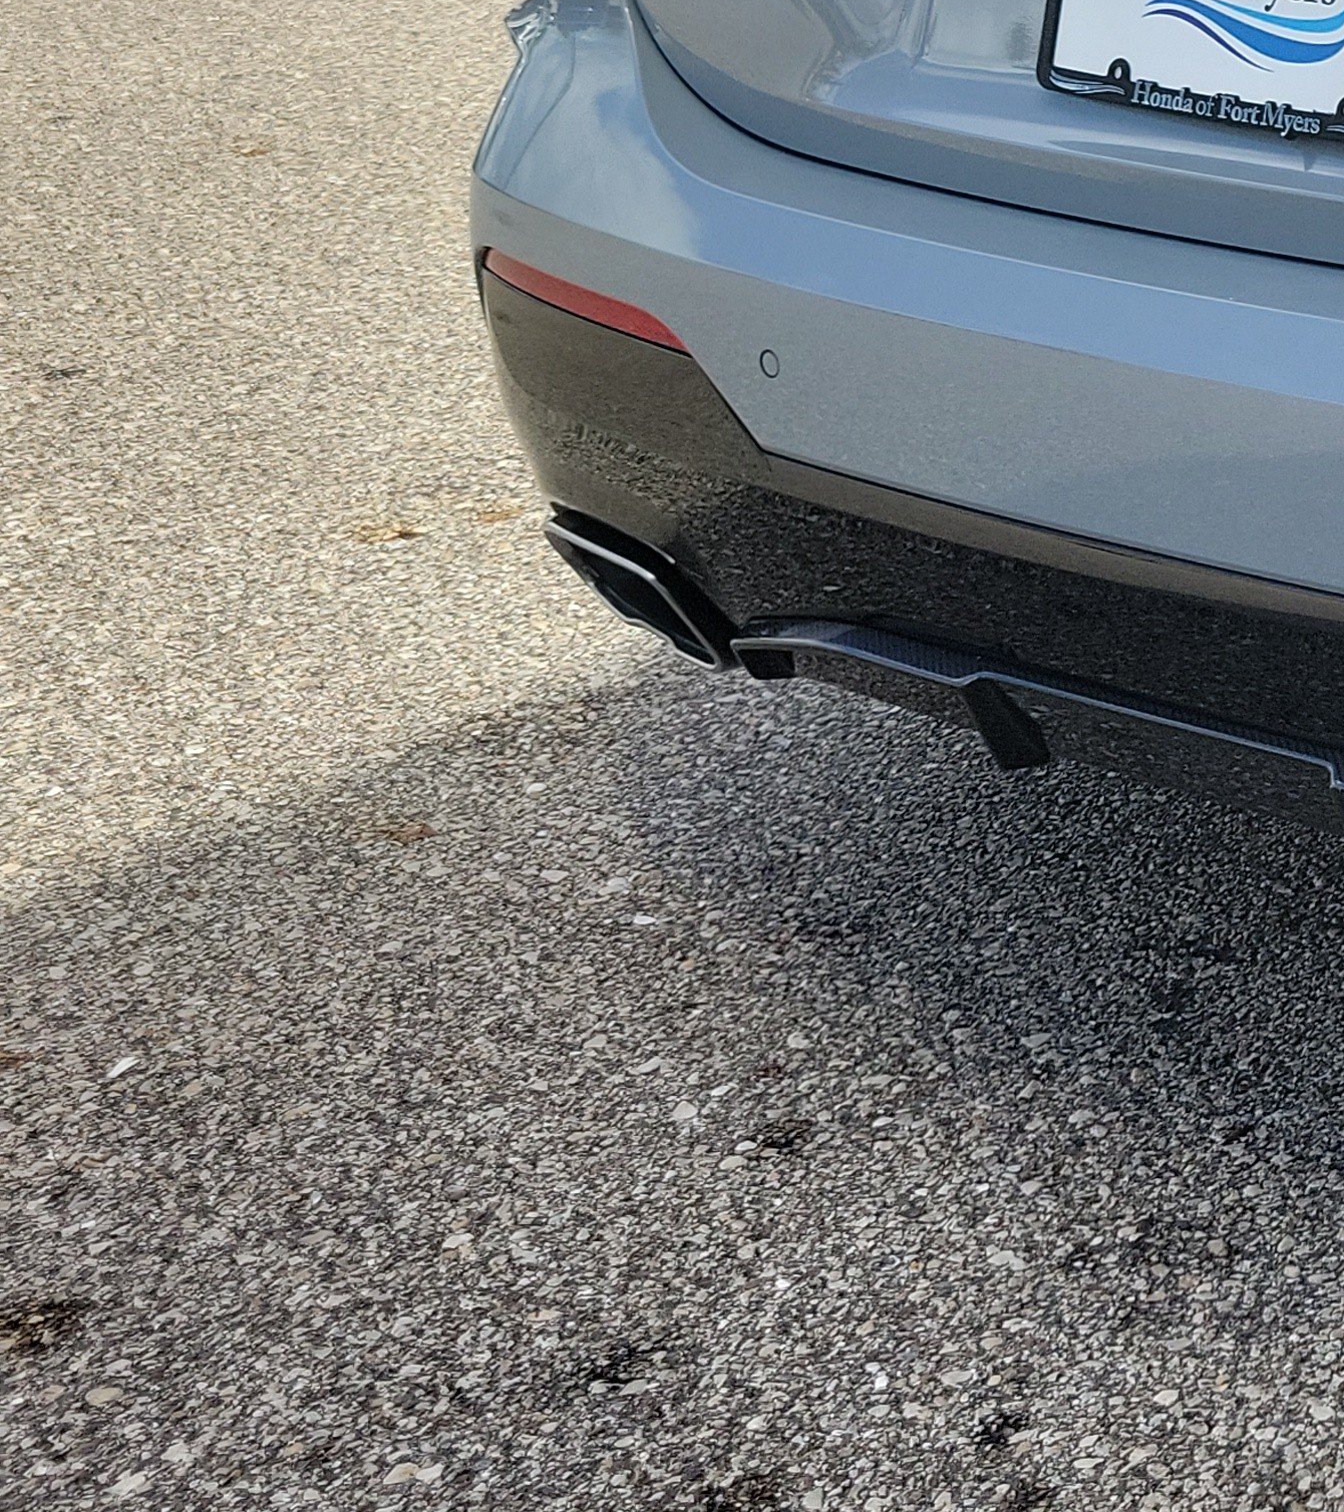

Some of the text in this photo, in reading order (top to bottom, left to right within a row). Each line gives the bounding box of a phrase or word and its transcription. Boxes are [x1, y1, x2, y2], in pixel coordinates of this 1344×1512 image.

[1131, 80, 1321, 137] Honda of Fort Myers
